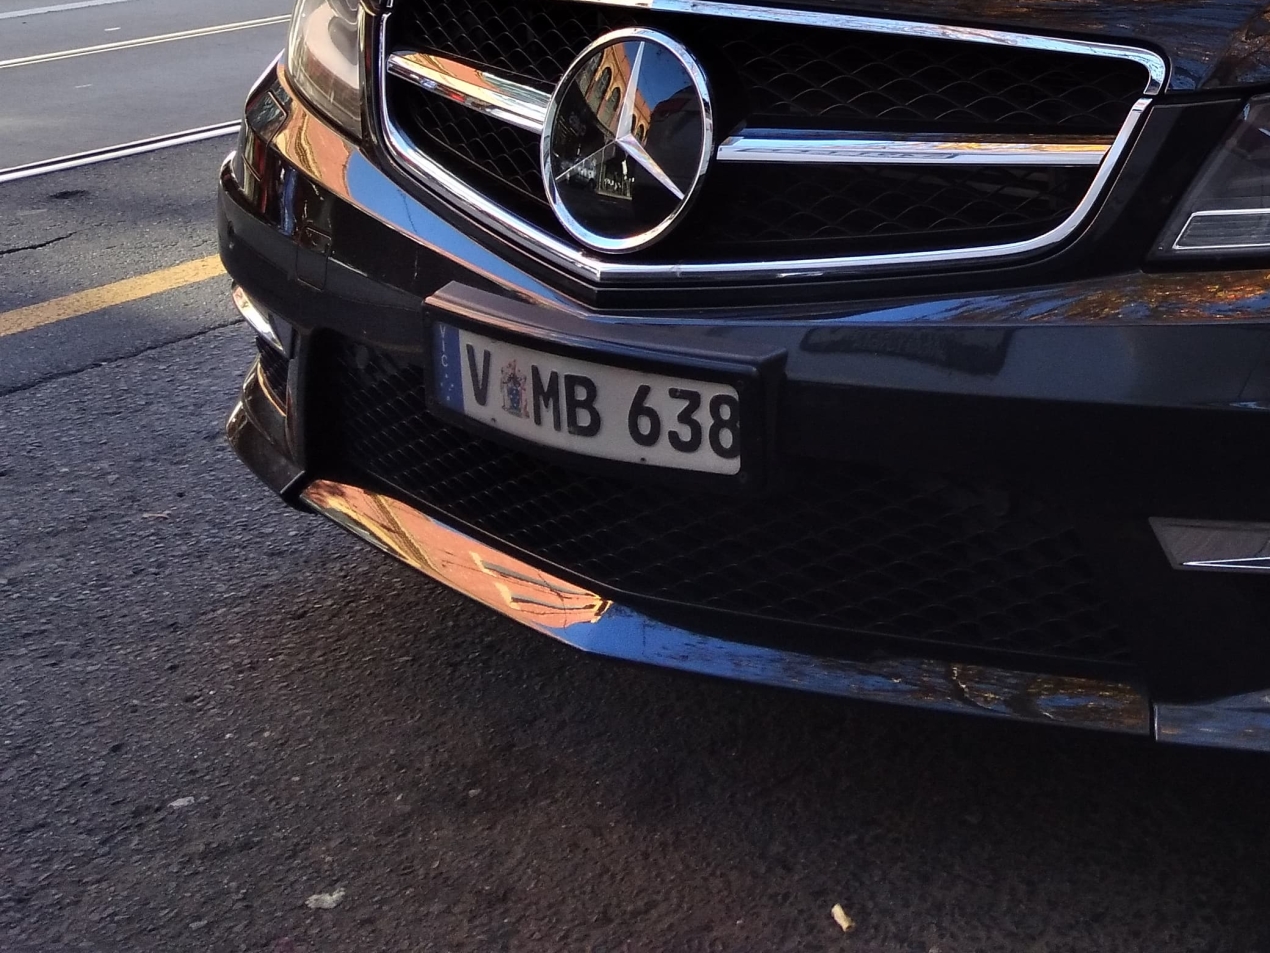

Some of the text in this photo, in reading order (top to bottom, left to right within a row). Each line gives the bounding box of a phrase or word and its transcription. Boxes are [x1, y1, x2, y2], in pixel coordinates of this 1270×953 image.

[440, 325, 449, 368] VIC
[466, 343, 740, 459] V MB 638
